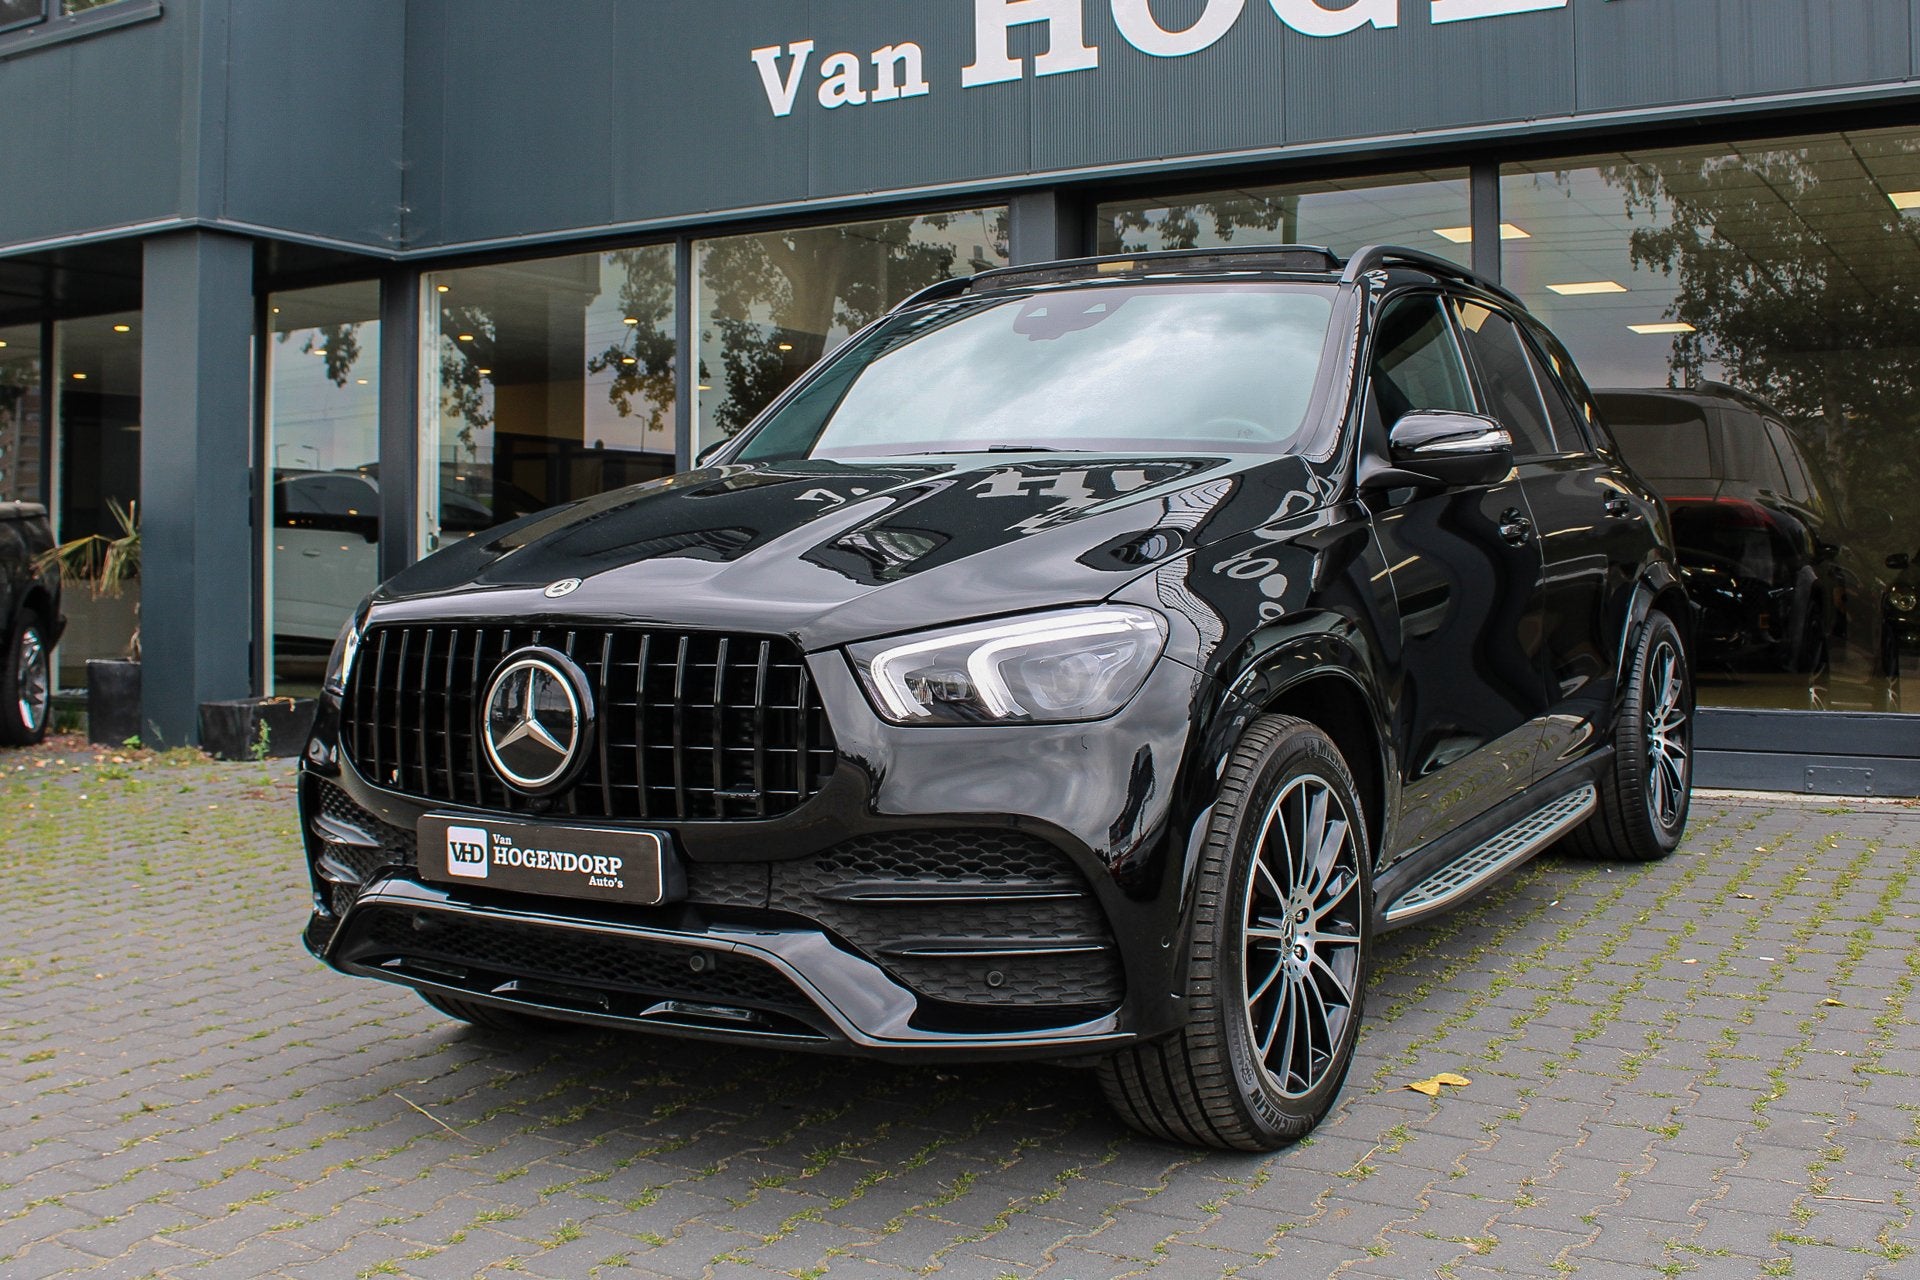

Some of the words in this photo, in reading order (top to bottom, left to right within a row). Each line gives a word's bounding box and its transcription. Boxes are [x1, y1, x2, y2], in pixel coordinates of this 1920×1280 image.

[751, 40, 930, 117] Van
[492, 834, 512, 846] Van
[492, 846, 623, 876] HOGENDORP
[589, 875, 624, 889] Auto's
